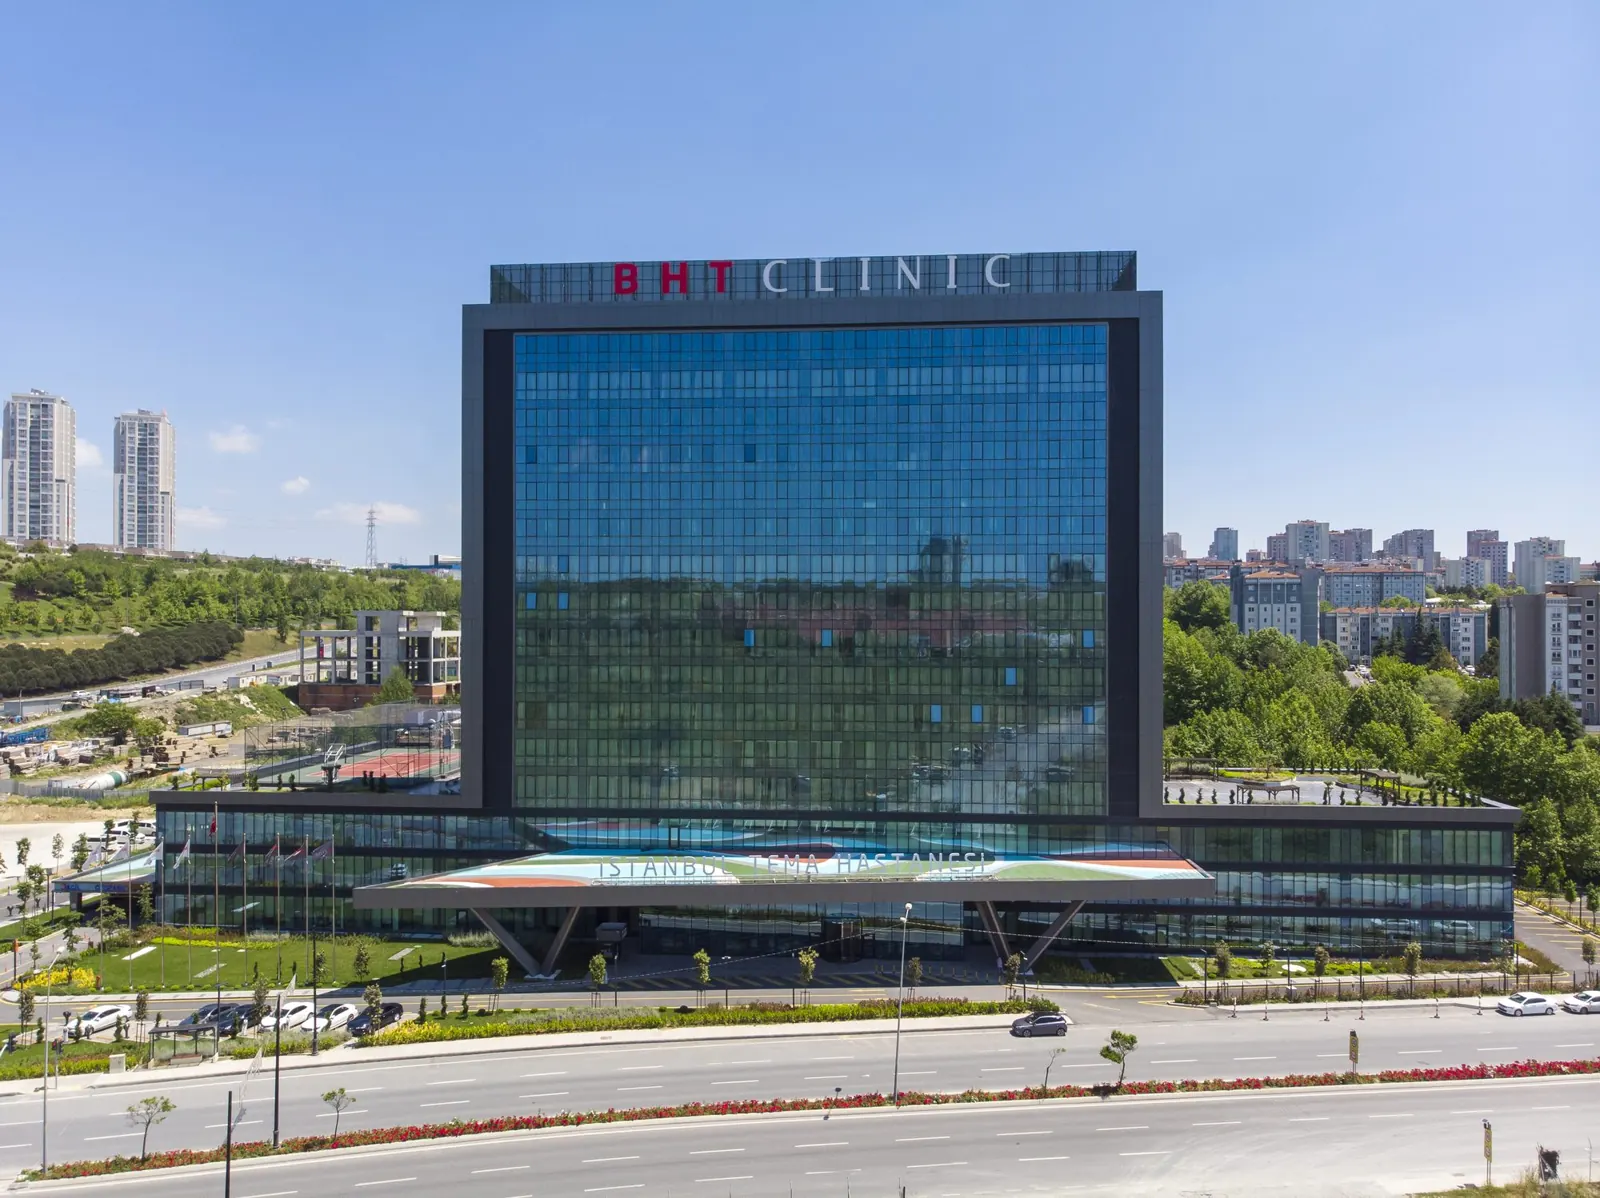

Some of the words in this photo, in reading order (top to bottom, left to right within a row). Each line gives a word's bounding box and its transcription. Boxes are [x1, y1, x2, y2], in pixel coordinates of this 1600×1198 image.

[614, 260, 733, 294] BHT
[762, 254, 1010, 293] CLINIC
[749, 853, 819, 876] TEMA
